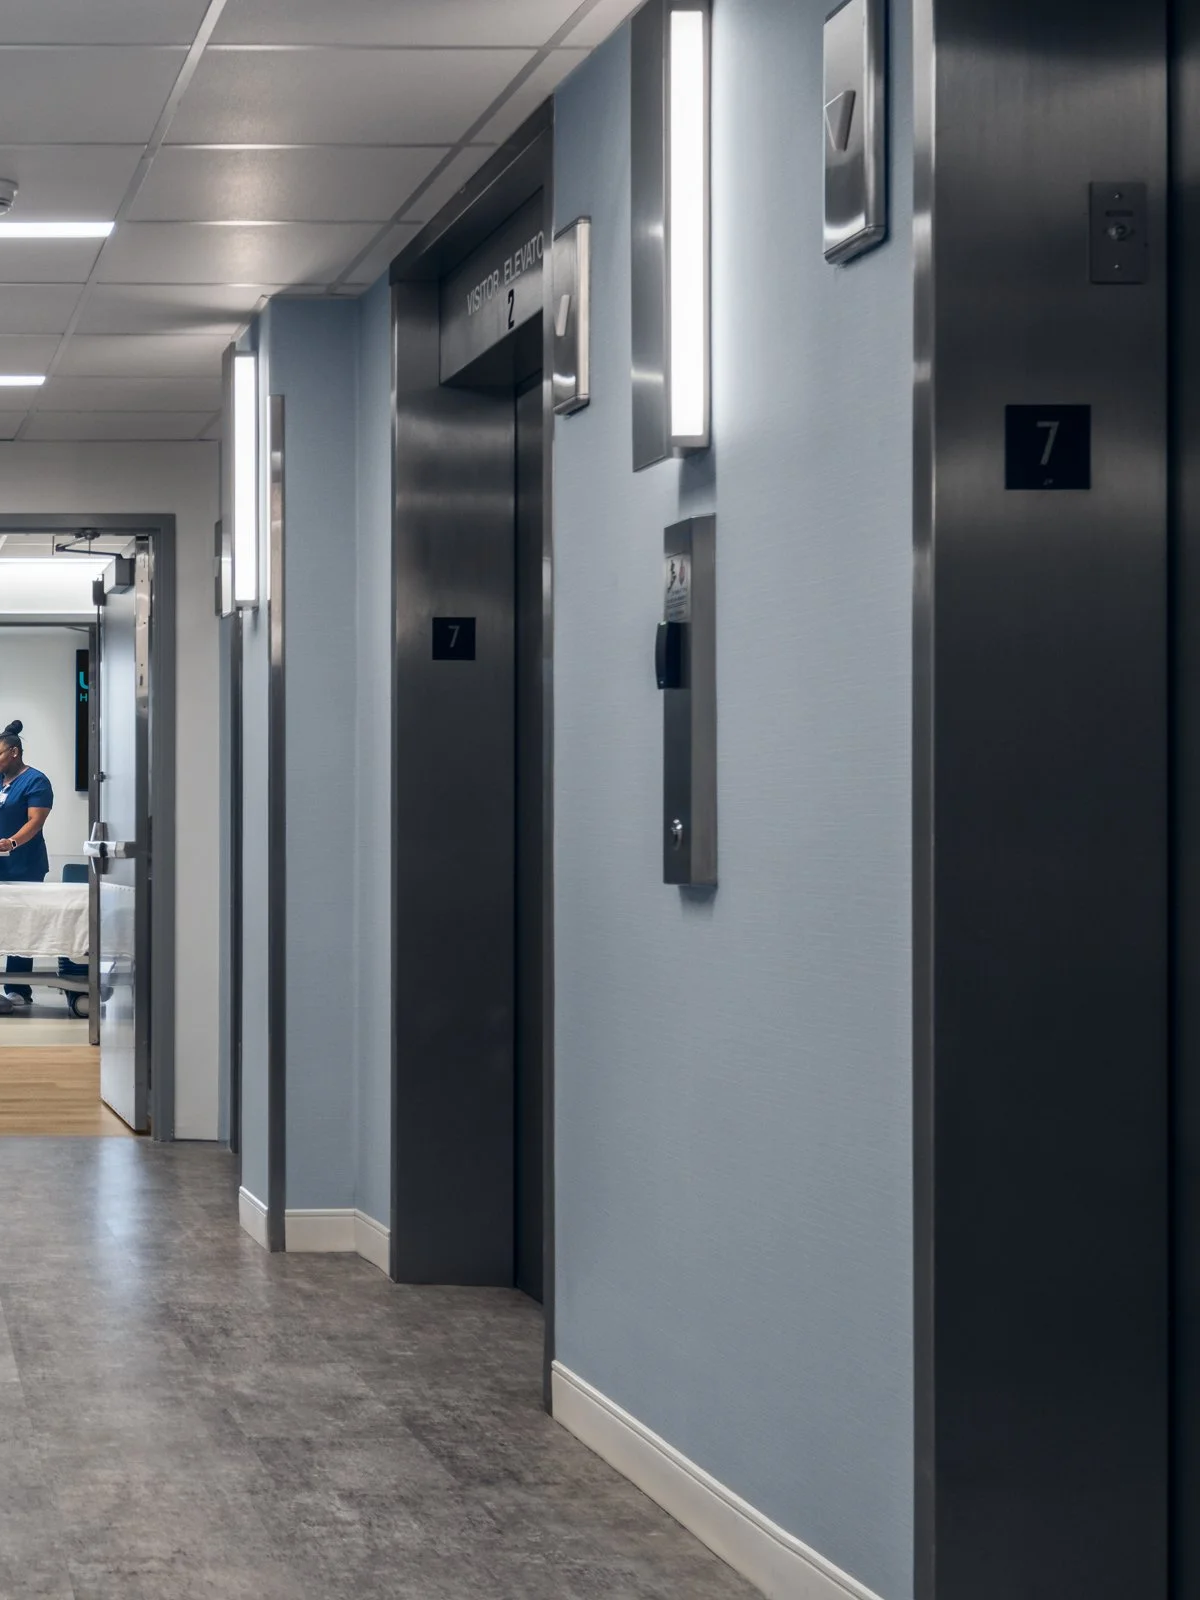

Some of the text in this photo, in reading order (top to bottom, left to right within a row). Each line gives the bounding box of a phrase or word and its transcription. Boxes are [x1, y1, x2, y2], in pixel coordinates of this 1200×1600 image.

[467, 231, 544, 316] VISITOR ELEVATO
[508, 288, 514, 330] 2
[1036, 421, 1060, 465] 7
[448, 625, 460, 648] 7
